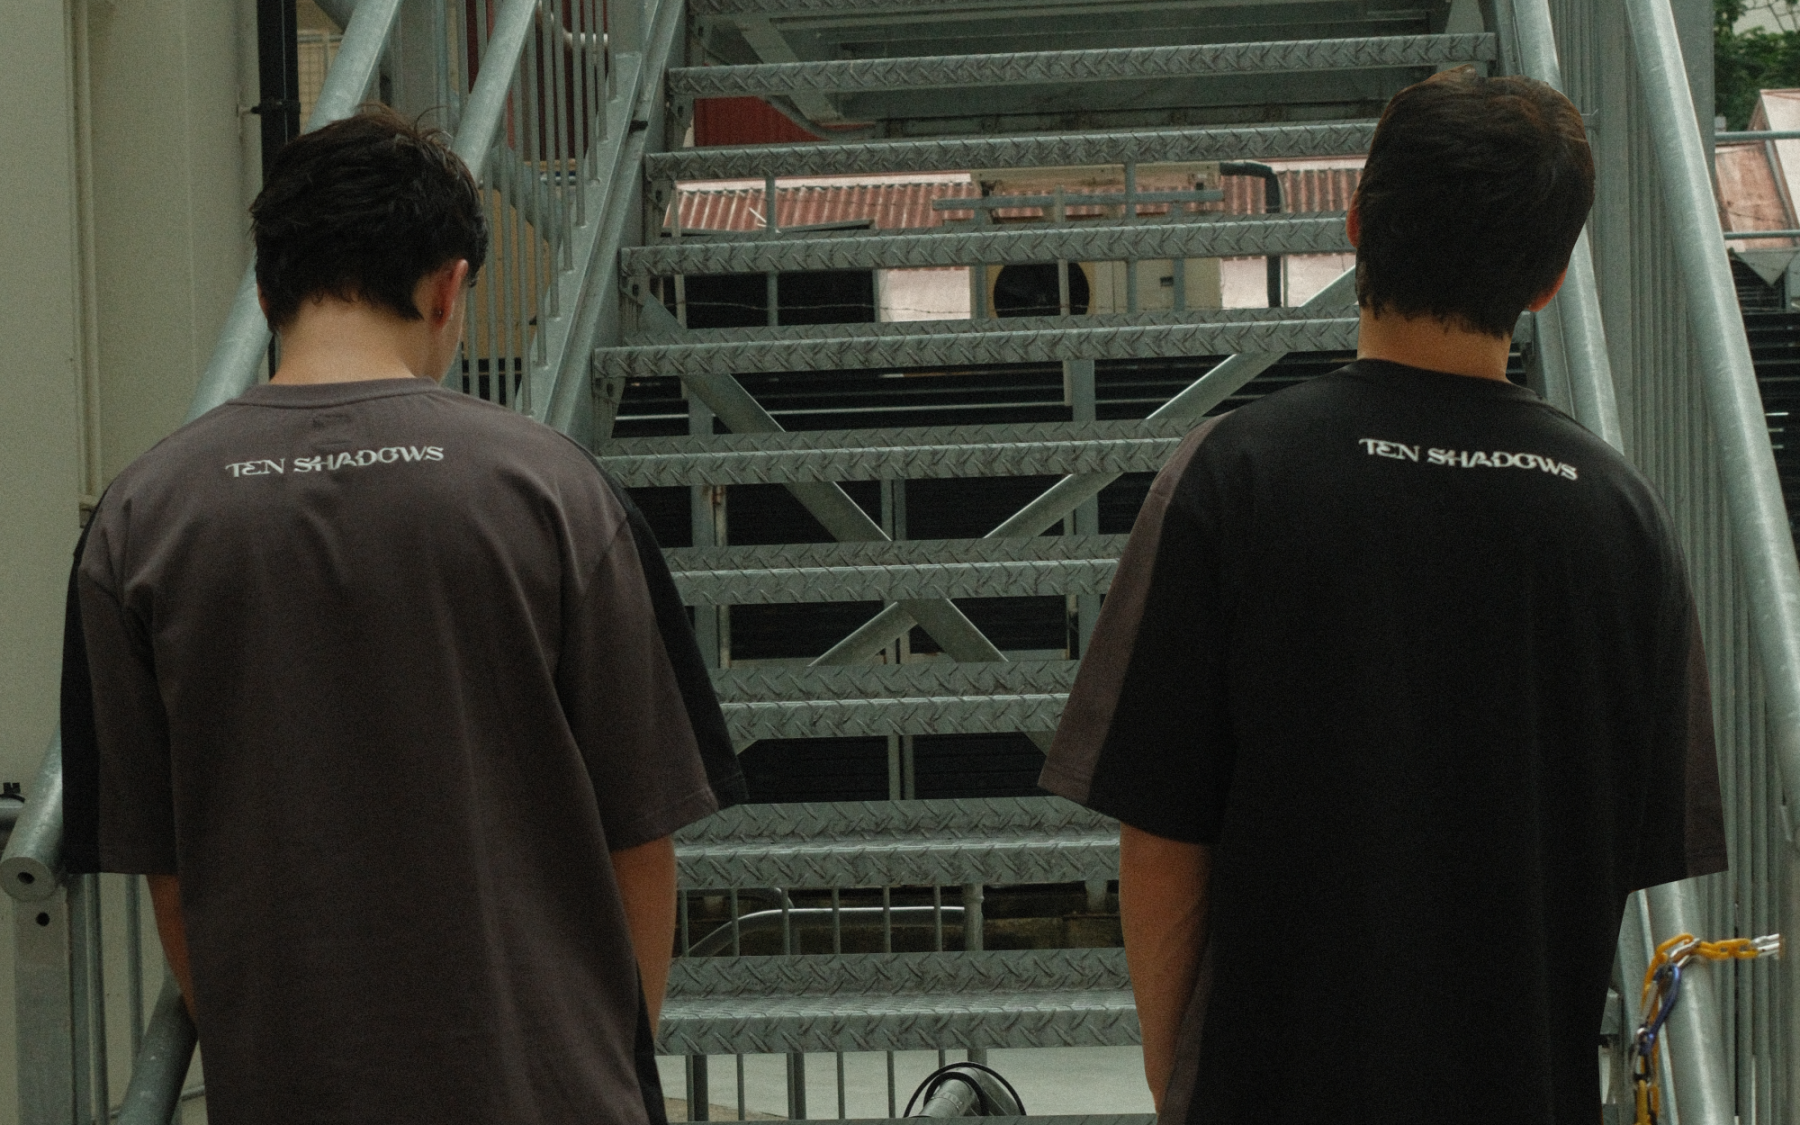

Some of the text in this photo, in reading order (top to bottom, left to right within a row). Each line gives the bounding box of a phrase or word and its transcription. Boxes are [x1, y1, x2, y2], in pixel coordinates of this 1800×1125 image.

[225, 445, 444, 478] TEN SHADOWS
[1358, 438, 1578, 481] TEN SHADOWS
